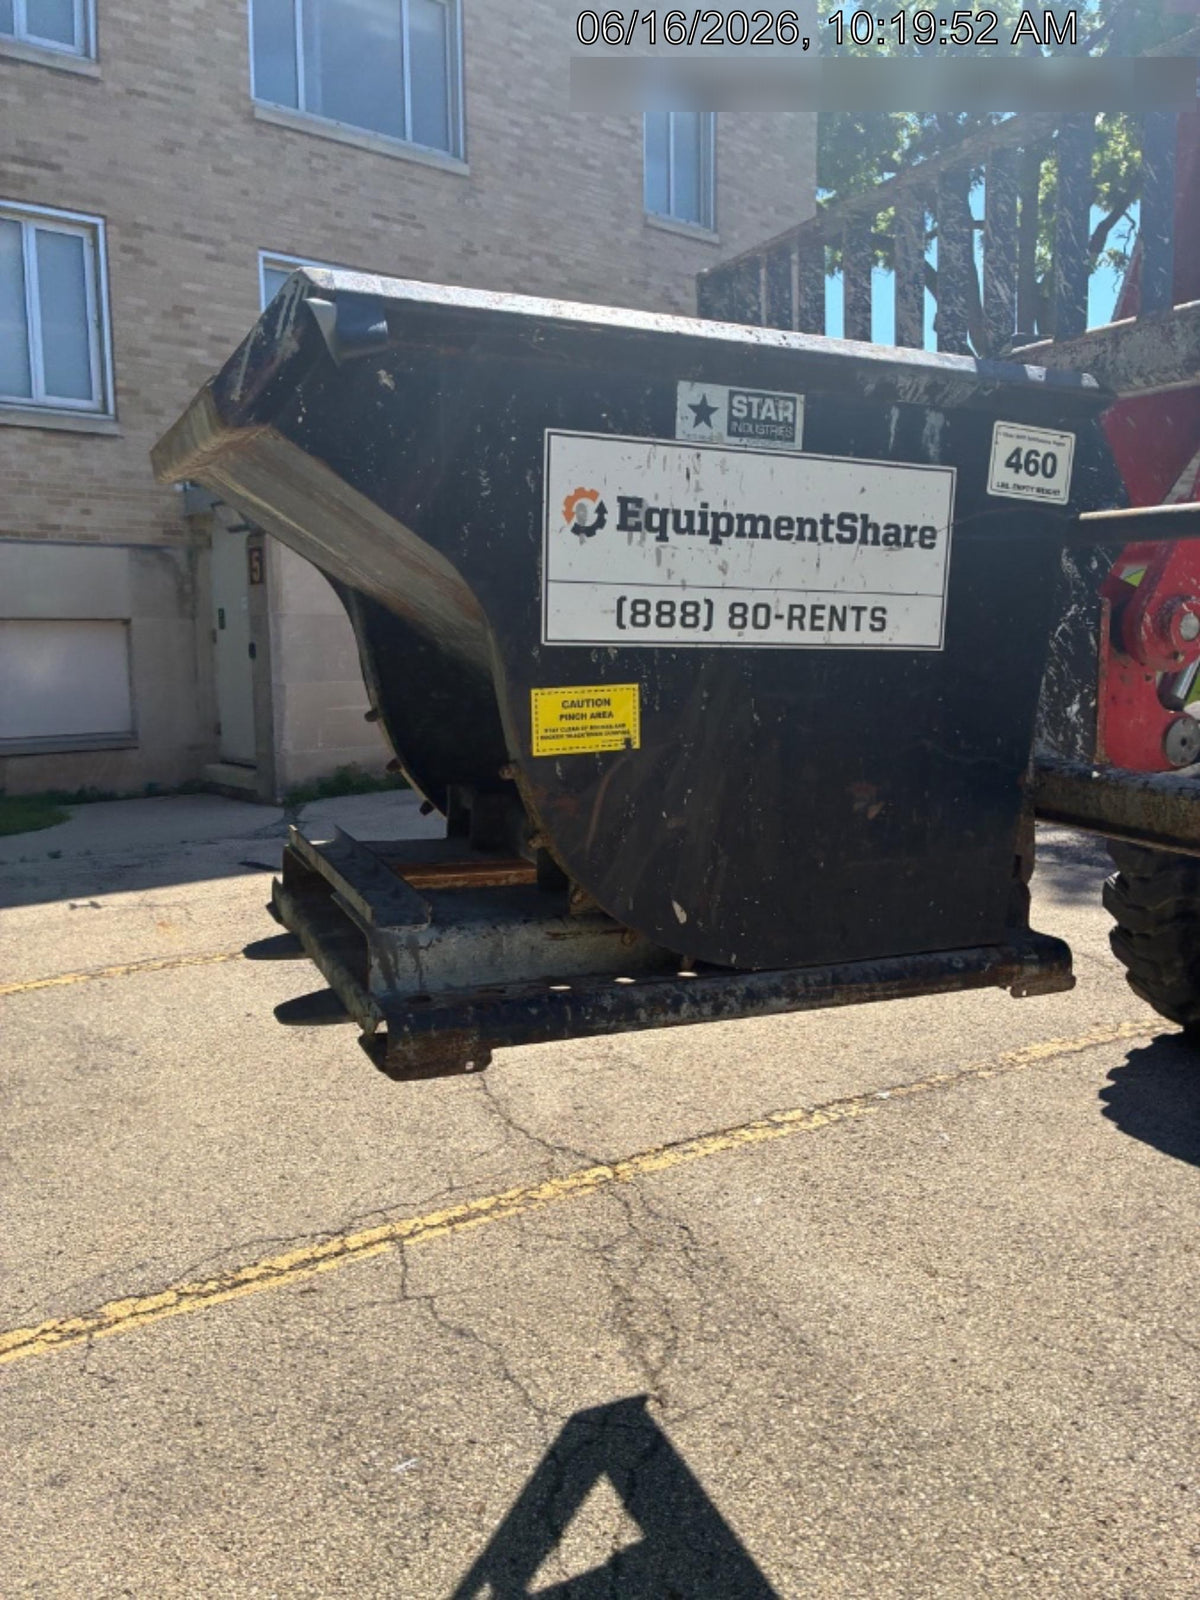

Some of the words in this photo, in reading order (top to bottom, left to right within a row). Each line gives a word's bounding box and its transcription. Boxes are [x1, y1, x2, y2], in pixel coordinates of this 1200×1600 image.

[732, 394, 794, 422] STAR
[1005, 446, 1057, 479] 460
[616, 496, 938, 550] EquipmentShare
[616, 596, 714, 630] (888)
[728, 602, 887, 632] 80-RENTS
[559, 713, 587, 721] PINCH
[590, 711, 614, 719] AREA
[561, 698, 611, 709] CAUTION
